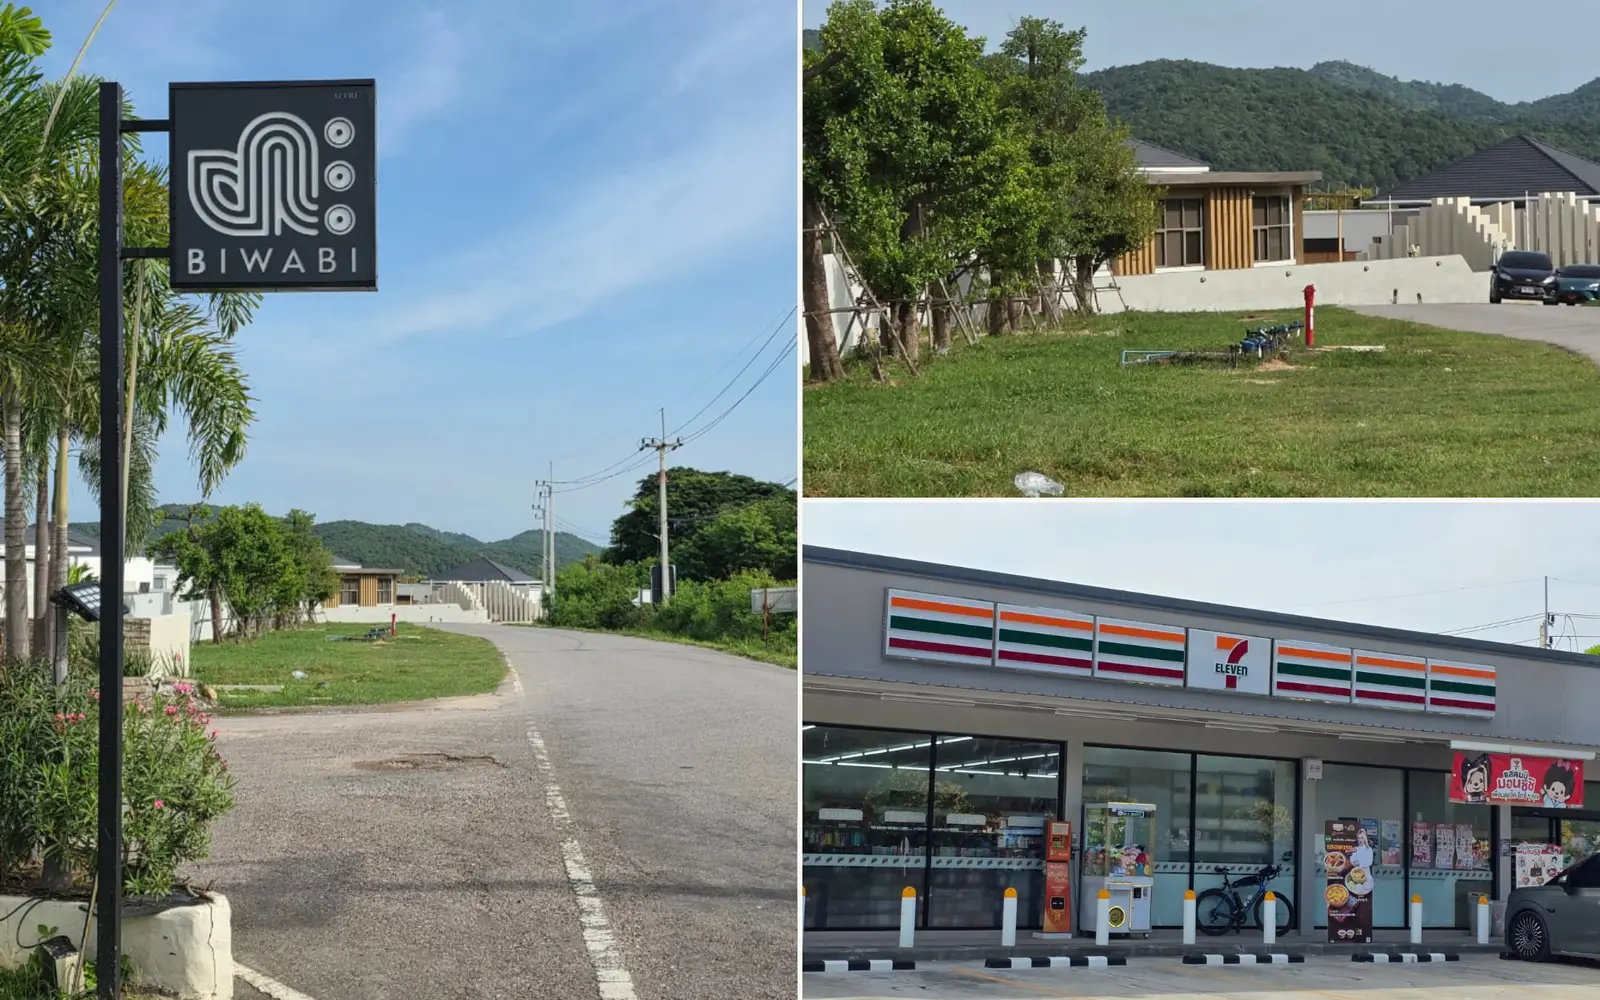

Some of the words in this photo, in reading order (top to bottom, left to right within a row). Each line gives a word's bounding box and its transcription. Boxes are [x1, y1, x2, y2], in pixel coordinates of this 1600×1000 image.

[187, 247, 357, 275] BIWABI
[1215, 663, 1248, 676] ELEVEN
[1216, 635, 1248, 688] 7
[1337, 929, 1355, 938] 99
